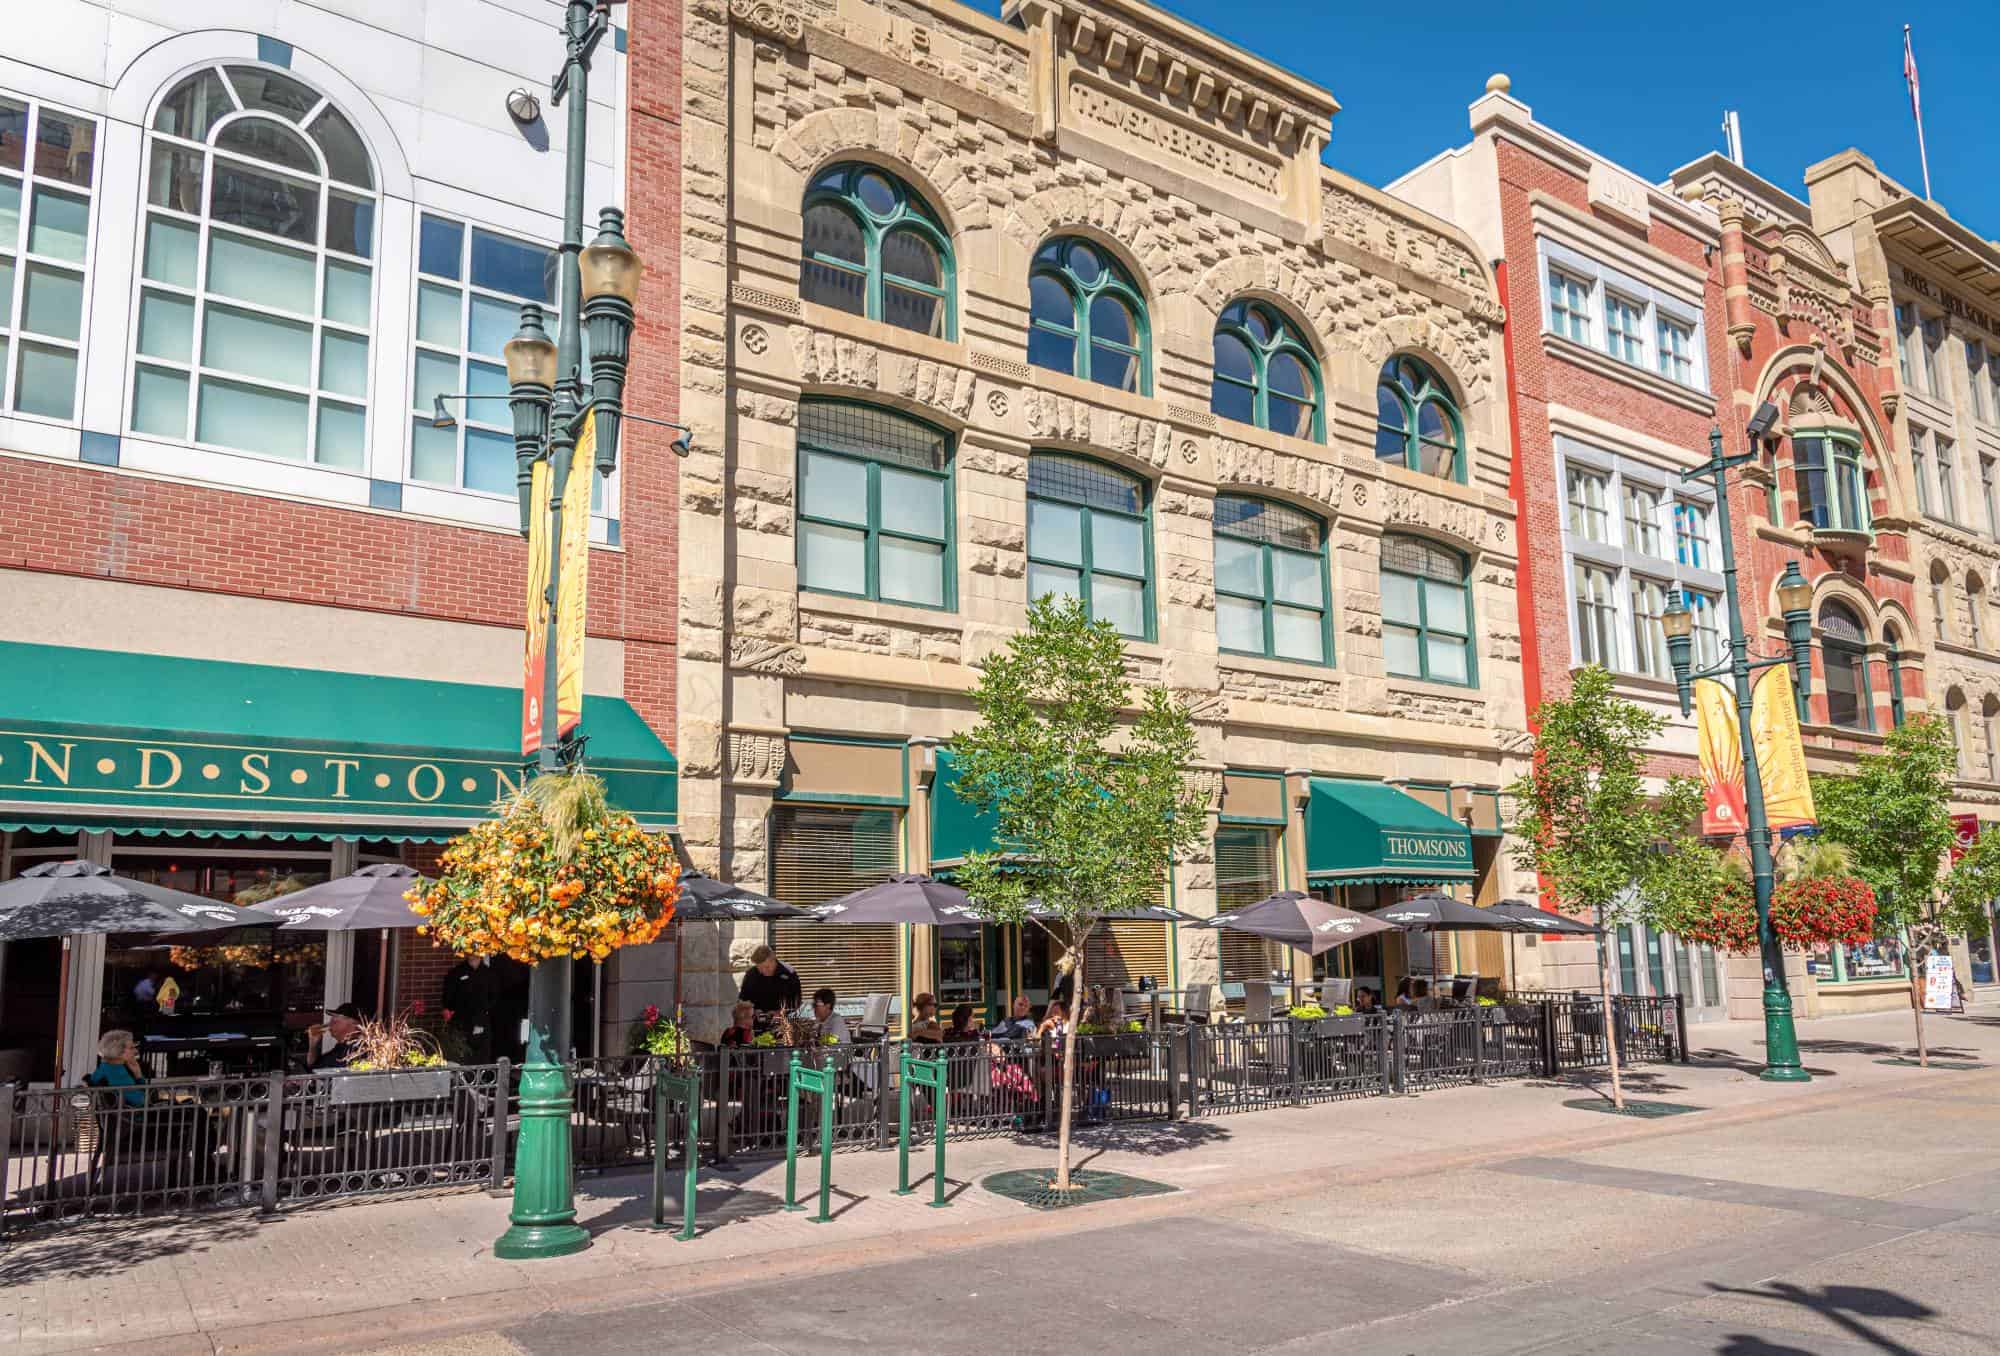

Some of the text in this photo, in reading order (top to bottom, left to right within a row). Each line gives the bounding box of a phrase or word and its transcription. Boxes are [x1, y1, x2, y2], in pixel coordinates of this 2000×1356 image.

[1775, 669, 1807, 791] Stephen Avenue Walk
[1387, 837, 1467, 858] THOMSONS
